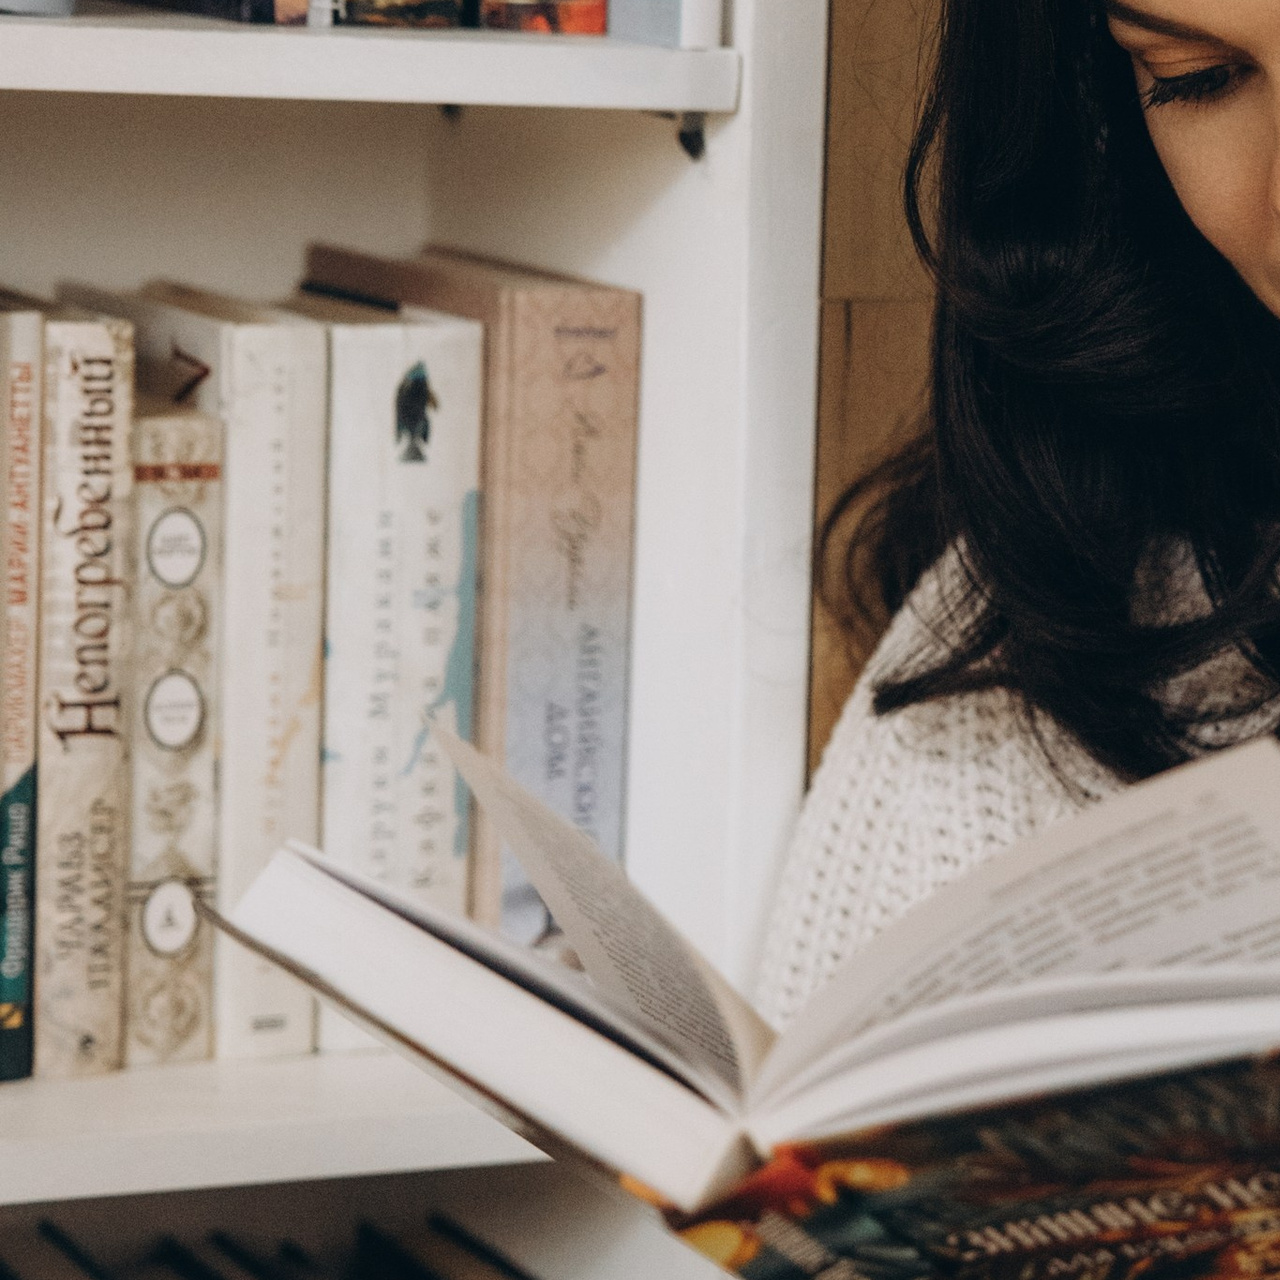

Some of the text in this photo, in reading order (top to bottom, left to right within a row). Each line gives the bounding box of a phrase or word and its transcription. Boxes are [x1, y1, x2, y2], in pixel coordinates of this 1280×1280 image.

[46, 356, 132, 756] Непогребенный
[4, 619, 28, 762] ПАРИКМАХЕР
[370, 510, 400, 880] аруки Мураками
[1, 803, 31, 979] Фредерик Ришо
[412, 750, 447, 889] Кафка
